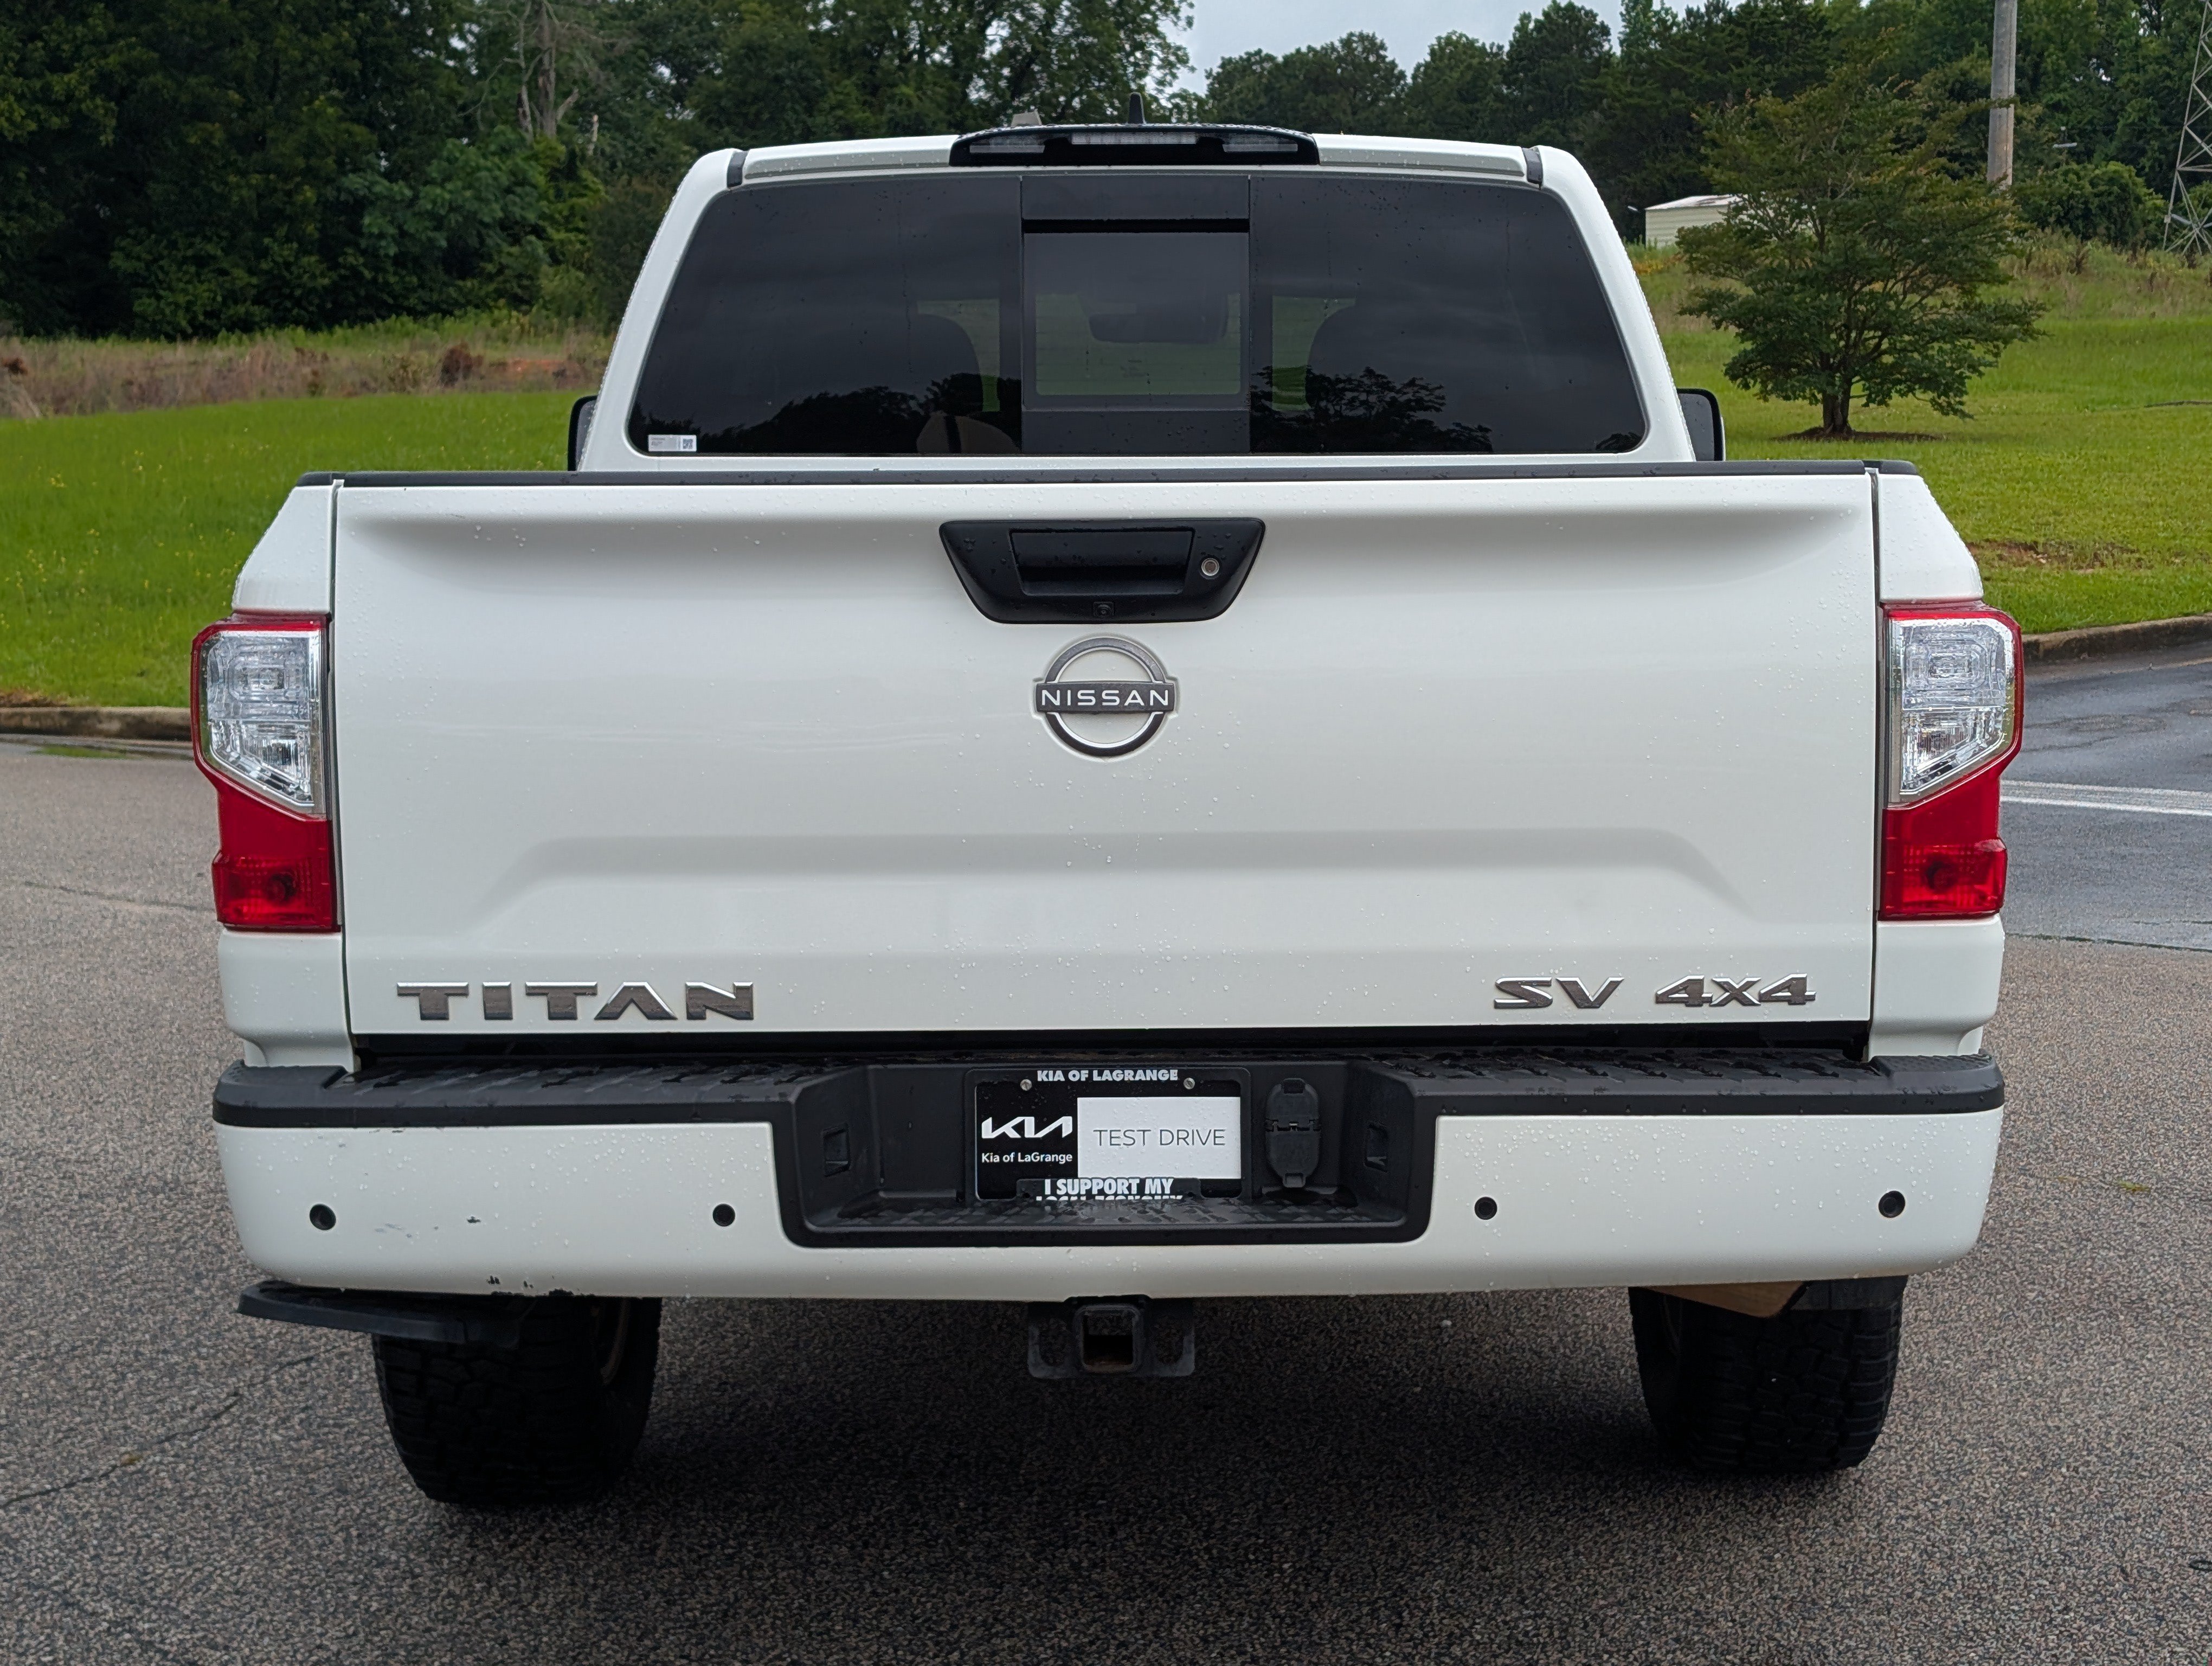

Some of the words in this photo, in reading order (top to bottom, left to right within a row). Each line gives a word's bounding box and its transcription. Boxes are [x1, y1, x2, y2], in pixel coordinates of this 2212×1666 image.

[1041, 690, 1168, 706] NISSAN
[397, 982, 754, 1020] TITAN
[1494, 977, 1625, 1009] SV
[1037, 1071, 1063, 1081] KIA
[1068, 1070, 1089, 1081] OF
[1093, 1069, 1178, 1081] LAGRANGE
[982, 1116, 1072, 1138] KIA
[1093, 1129, 1152, 1146] TEST
[1159, 1129, 1226, 1146] DRIVE
[982, 1152, 1000, 1162] Kia
[1002, 1152, 1015, 1162] of
[1018, 1152, 1073, 1164] LaGrange
[1044, 1178, 1051, 1195] I
[1056, 1178, 1140, 1195] SUPPORT
[1144, 1178, 1174, 1194] MY
